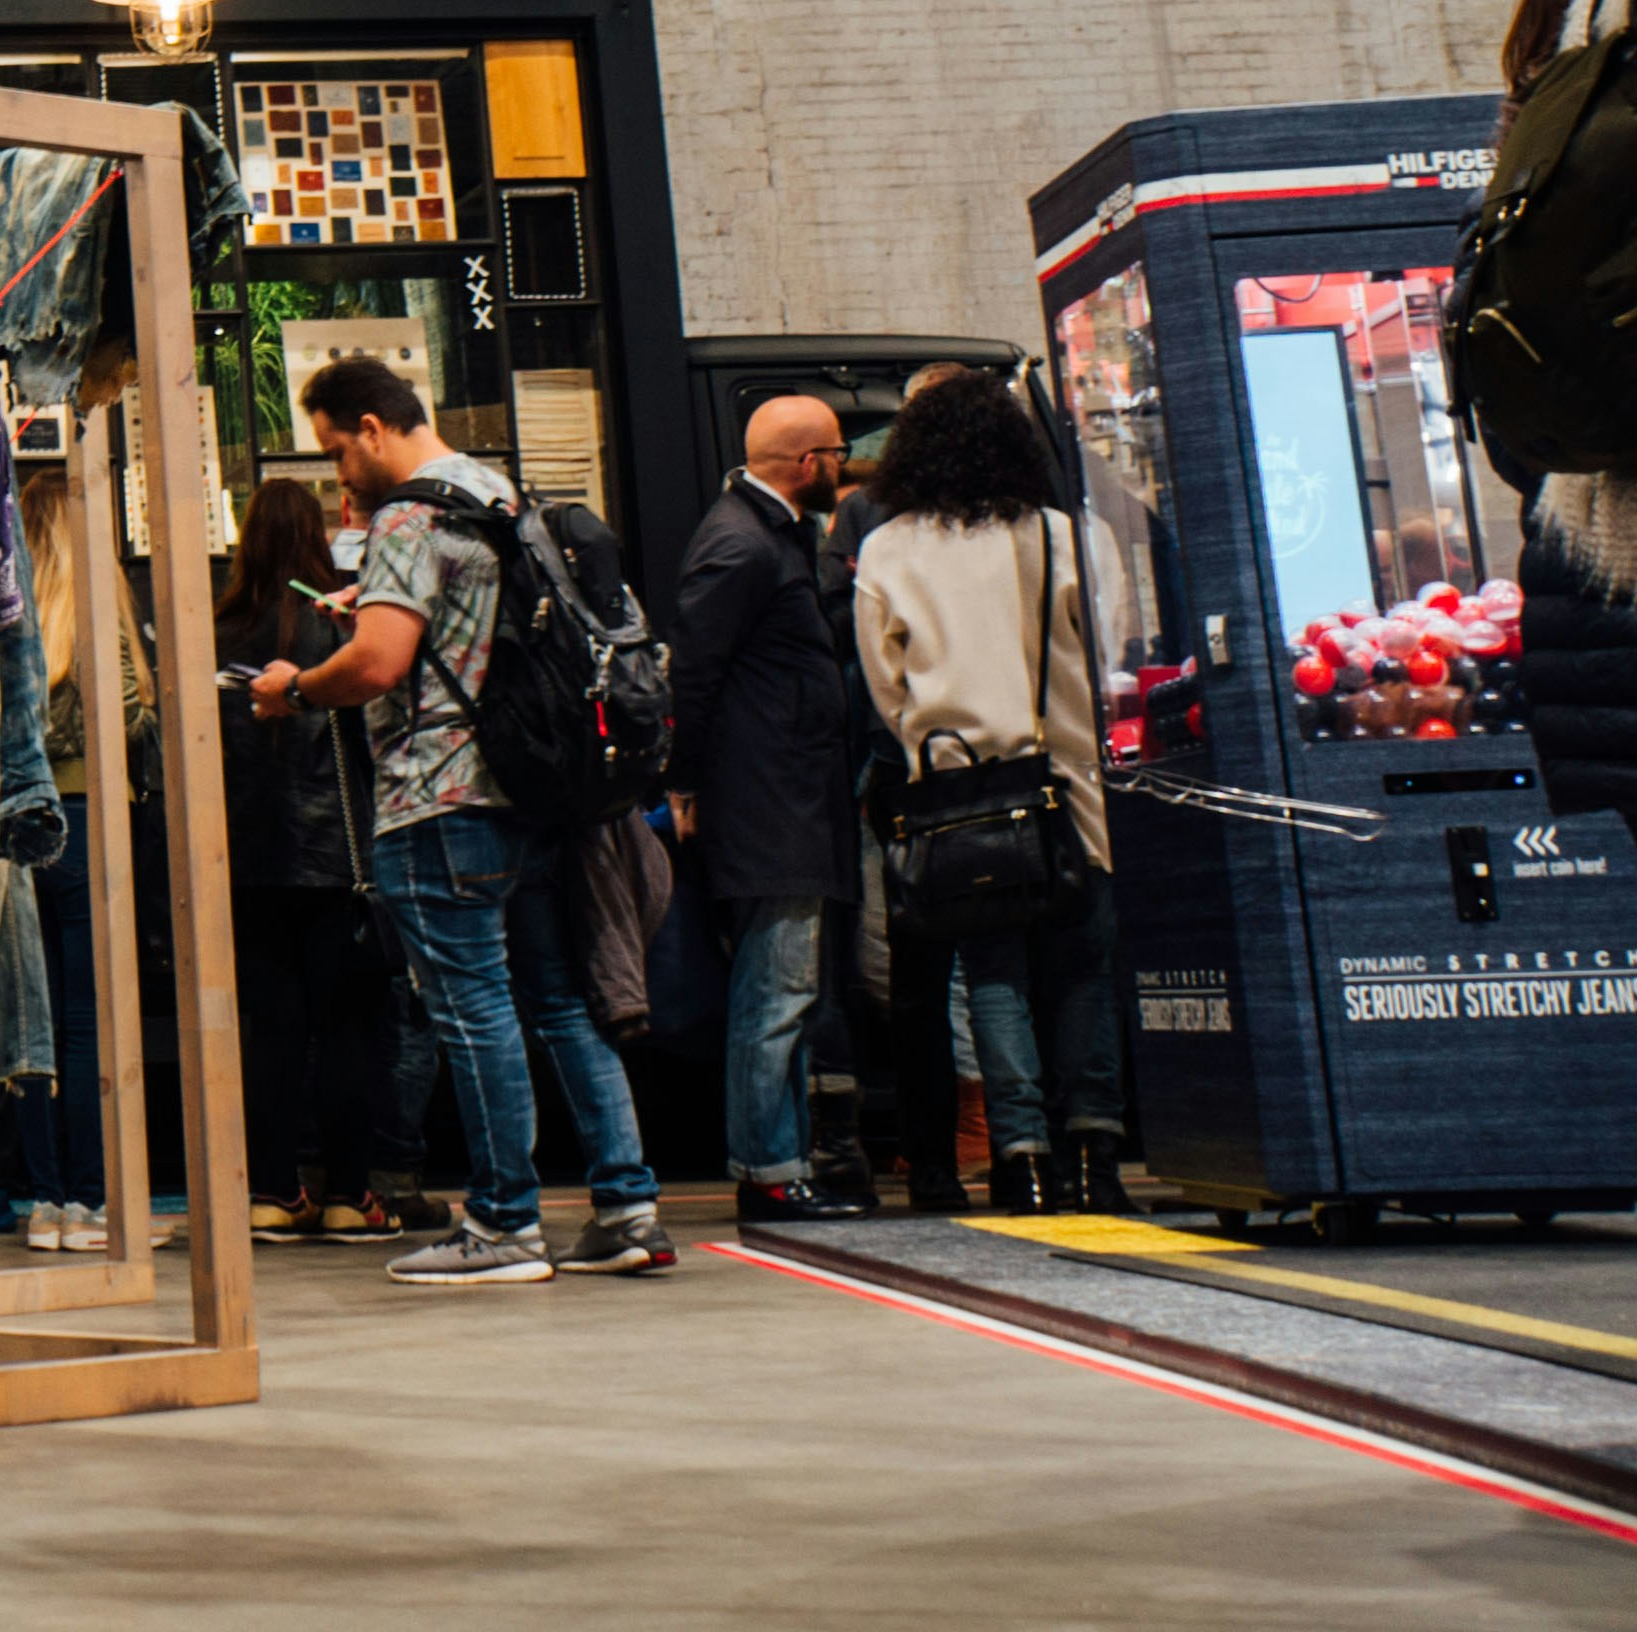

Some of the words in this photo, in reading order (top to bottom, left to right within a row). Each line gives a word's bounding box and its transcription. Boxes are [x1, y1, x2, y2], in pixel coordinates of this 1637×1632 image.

[1339, 955, 1426, 975] DYNAMIC
[1344, 983, 1459, 1021] SERIOUSLY
[1463, 980, 1571, 1018] STRETCHY
